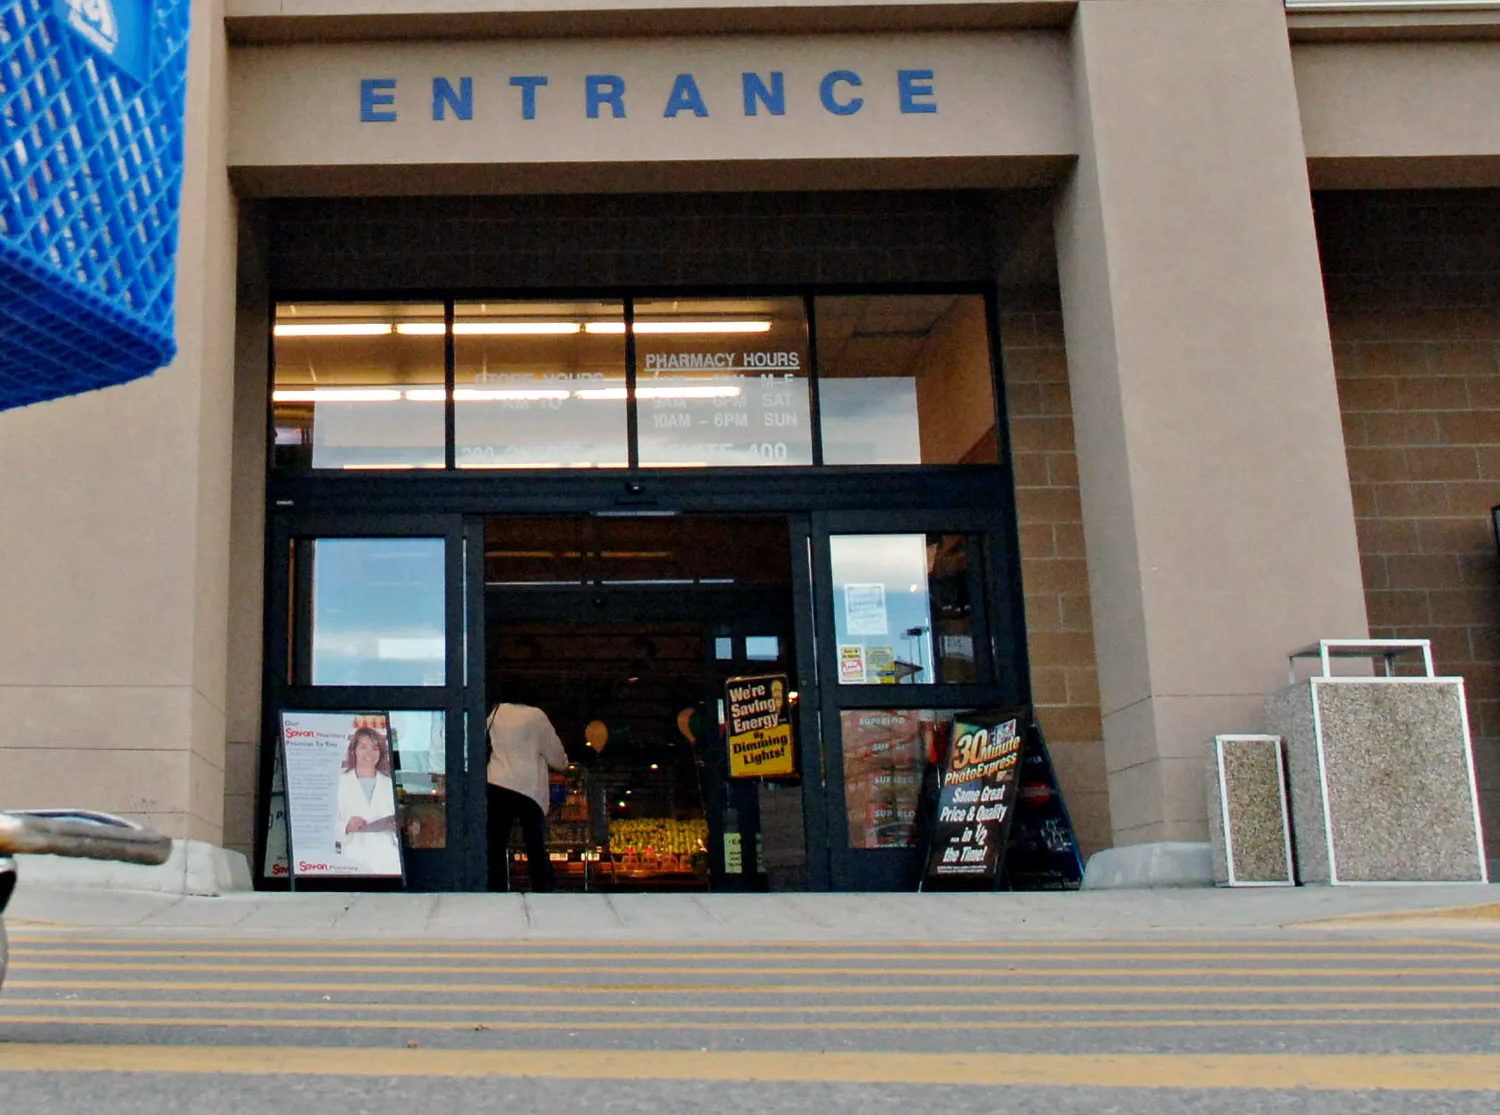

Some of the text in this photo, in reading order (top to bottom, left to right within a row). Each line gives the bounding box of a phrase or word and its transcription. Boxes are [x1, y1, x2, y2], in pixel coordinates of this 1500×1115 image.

[360, 69, 937, 122] ENTRANCE
[646, 352, 800, 368] PHARMACY HOURS
[762, 393, 794, 407] SAT
[653, 413, 690, 428] 10AM
[714, 413, 748, 428] 6PM
[764, 412, 798, 427] SUN
[729, 684, 765, 702] We're
[731, 698, 776, 718] Saving
[733, 735, 788, 754] Dimming
[953, 729, 1021, 771] 30 Minute
[743, 747, 785, 765] Lights!
[952, 787, 981, 803] Same
[980, 784, 1006, 802] Great
[939, 804, 1008, 823] Price & Quality
[943, 846, 988, 862] the Time!
